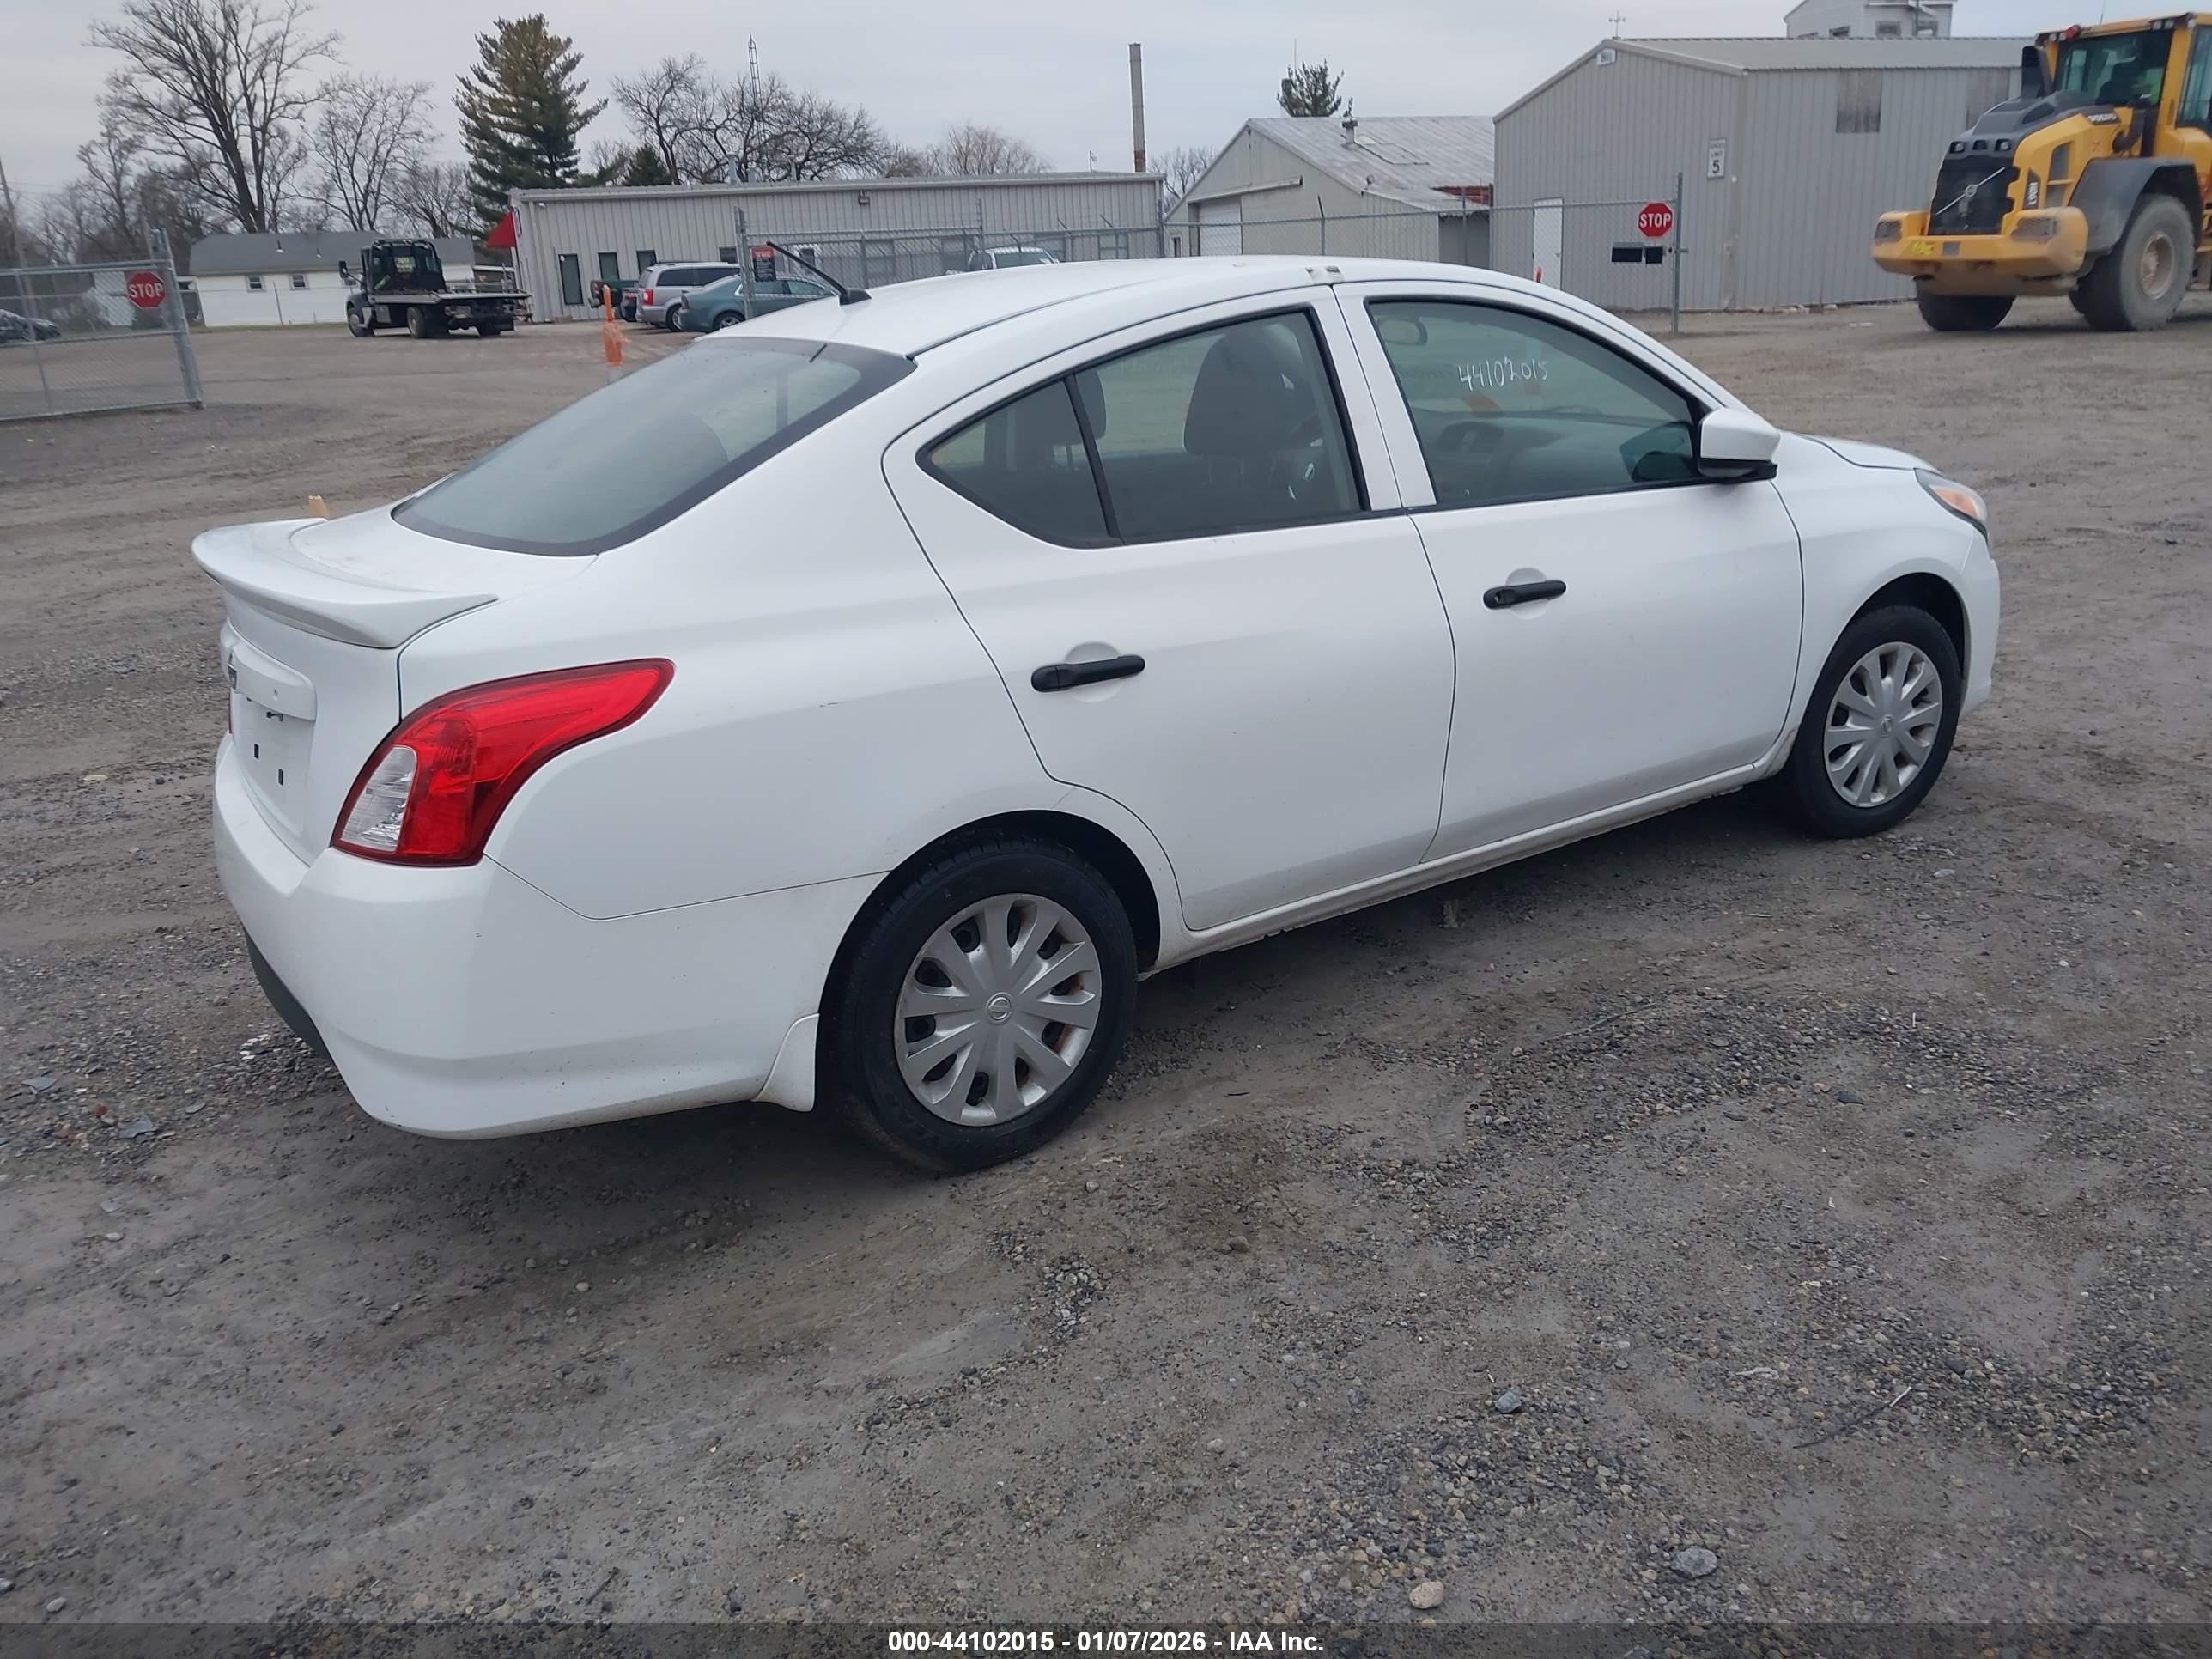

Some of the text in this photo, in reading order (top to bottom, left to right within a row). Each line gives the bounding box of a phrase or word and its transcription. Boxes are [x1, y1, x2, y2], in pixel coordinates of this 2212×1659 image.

[1712, 160, 1720, 173] 5
[1639, 213, 1671, 228] STOP
[129, 283, 163, 298] STOP
[1458, 356, 1547, 391] 44102015
